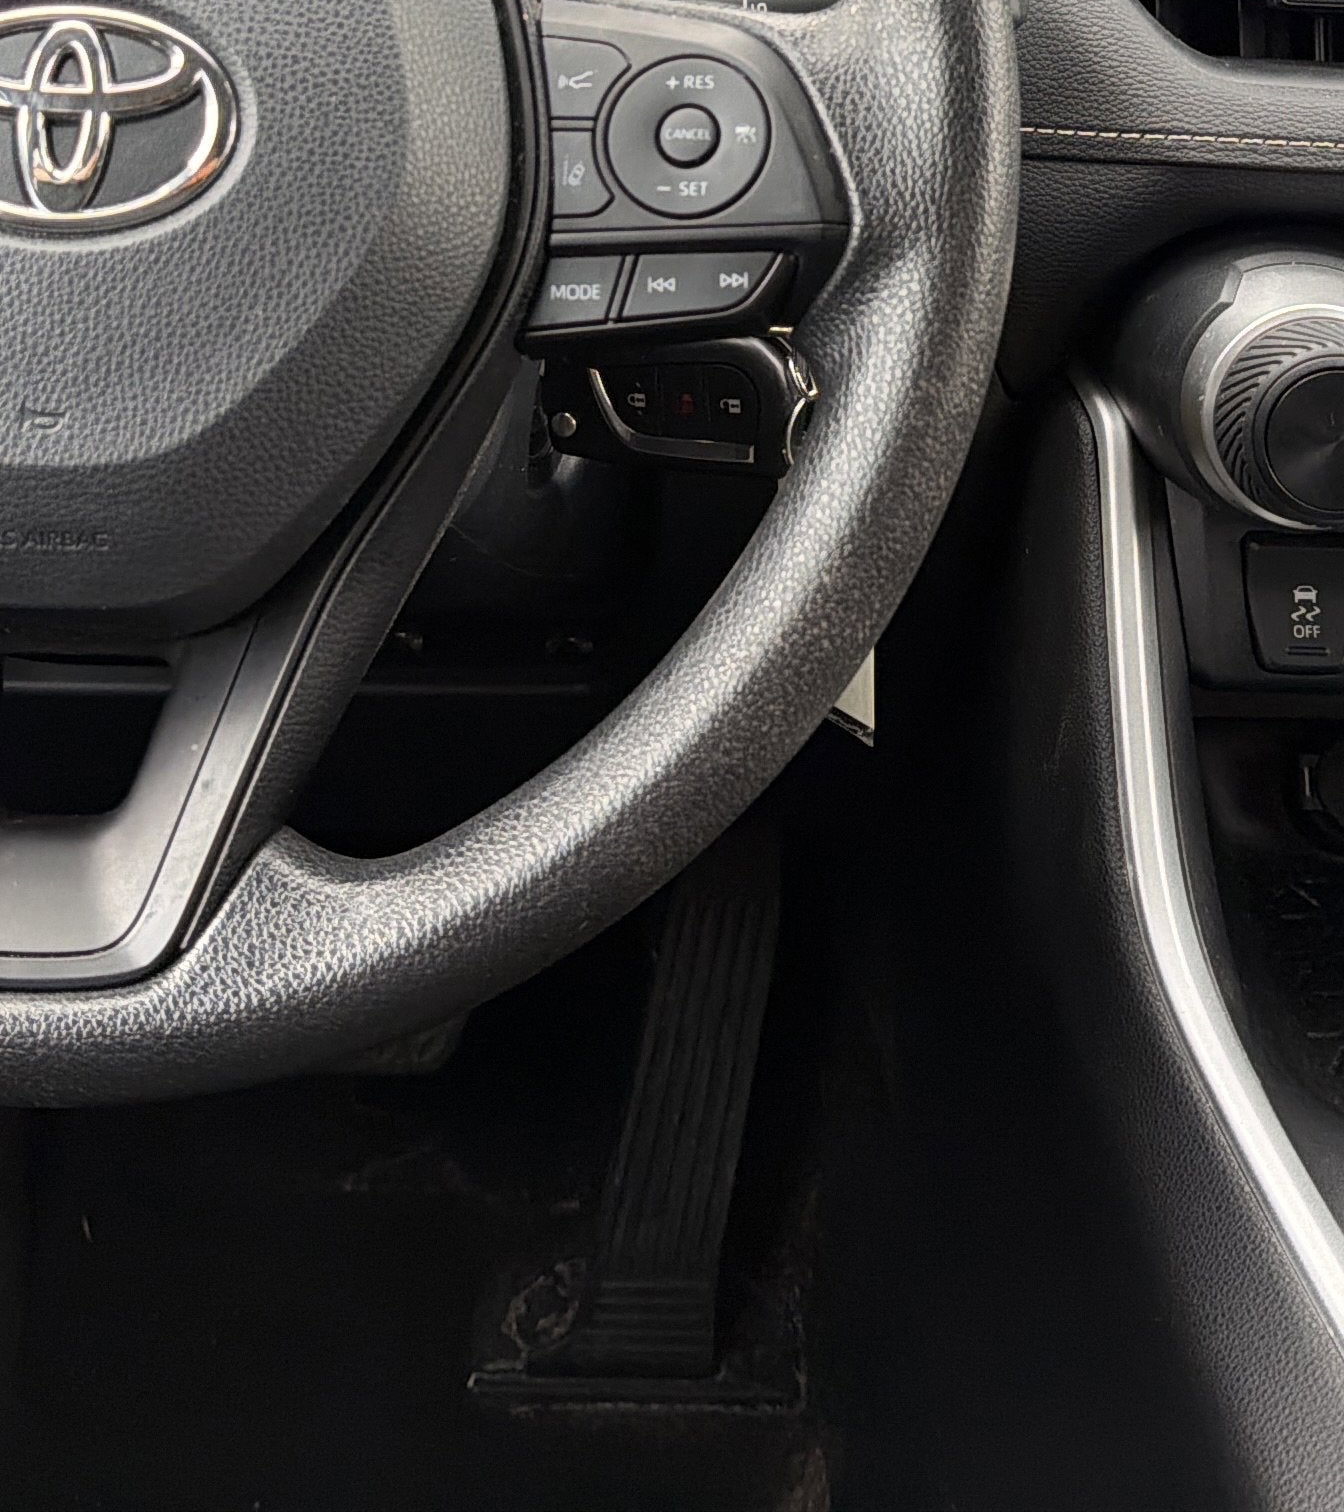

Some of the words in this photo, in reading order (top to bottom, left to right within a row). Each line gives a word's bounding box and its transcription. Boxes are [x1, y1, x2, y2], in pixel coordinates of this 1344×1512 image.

[683, 75, 715, 90] RES
[664, 127, 711, 142] CANCEL
[679, 181, 708, 197] SET
[550, 284, 601, 301] MODE
[1293, 625, 1320, 639] OFF
